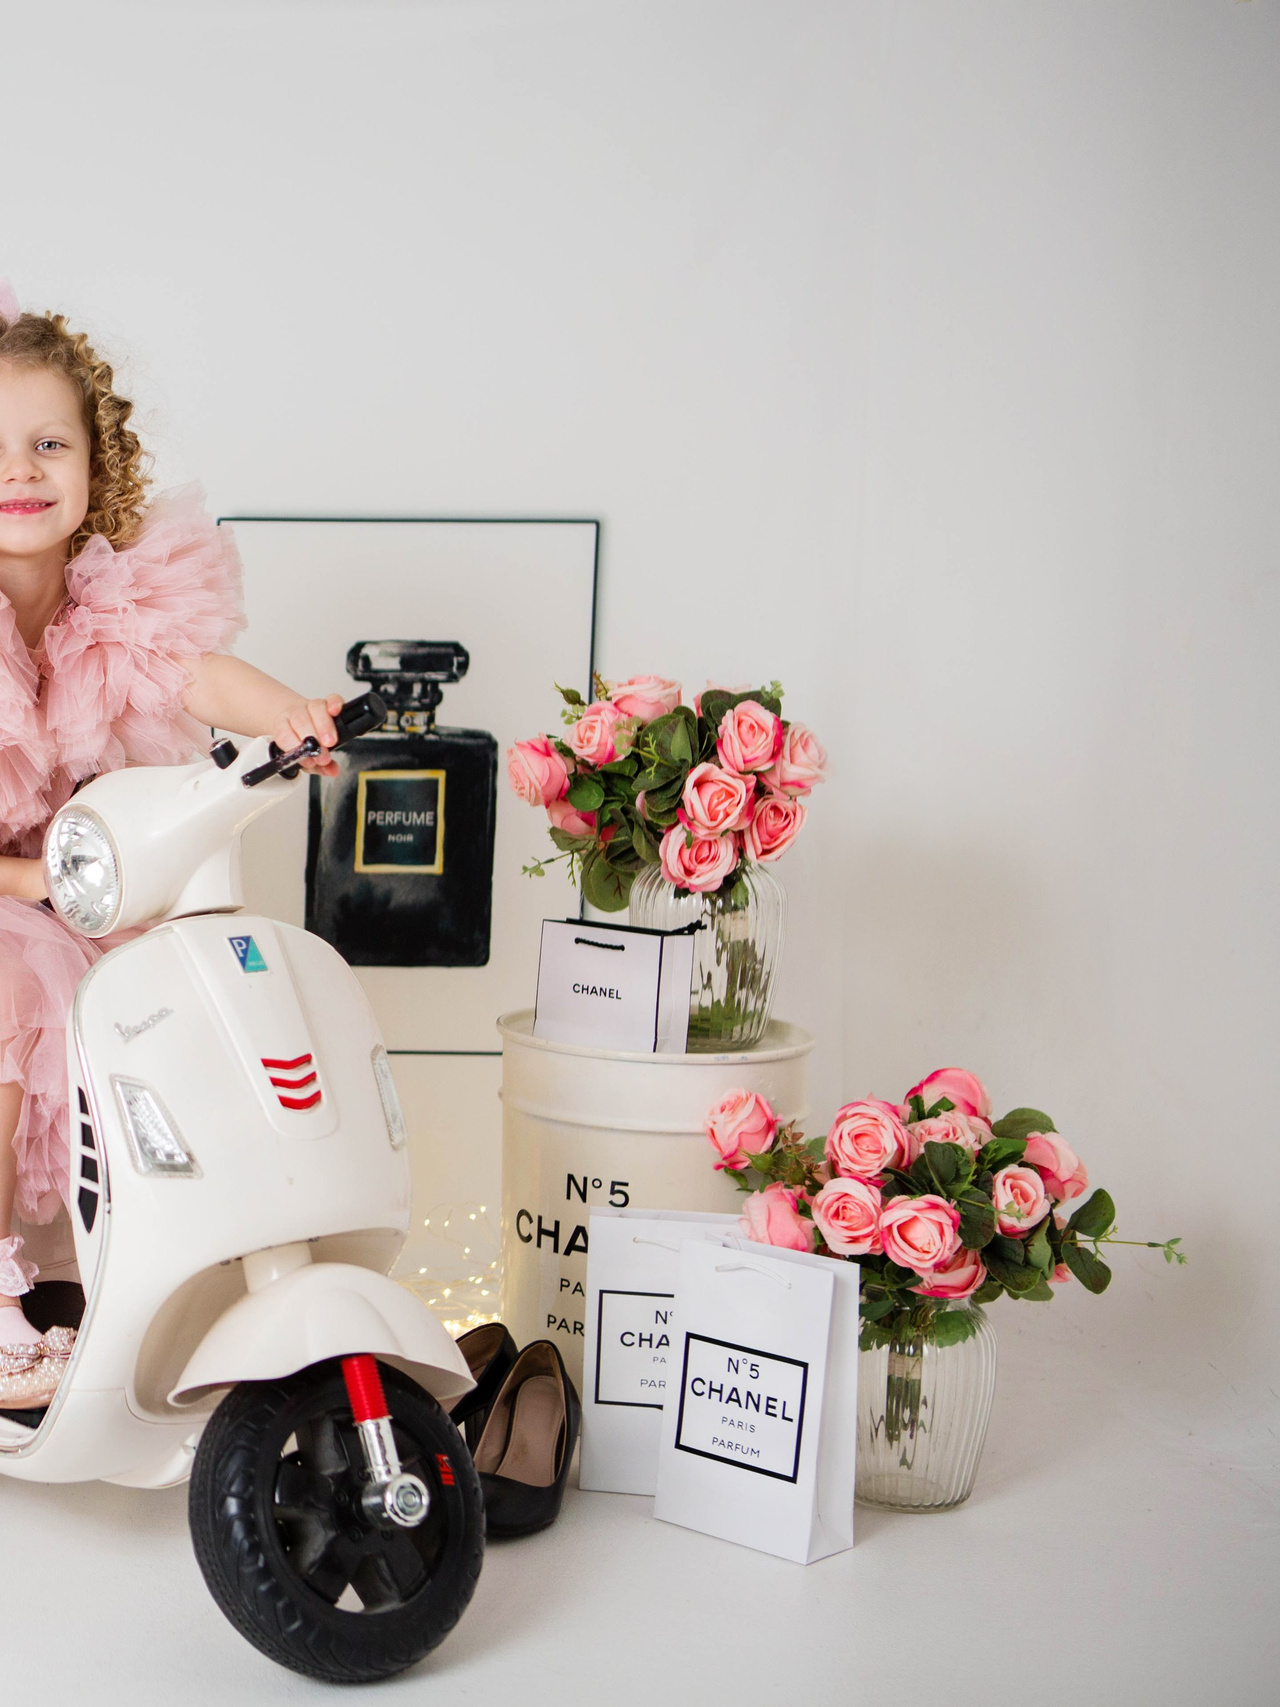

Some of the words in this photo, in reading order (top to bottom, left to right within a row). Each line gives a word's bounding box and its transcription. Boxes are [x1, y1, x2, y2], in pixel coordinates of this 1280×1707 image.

[367, 810, 435, 826] PERFUME
[231, 939, 247, 958] P
[572, 983, 622, 1000] CHANEL
[516, 1208, 589, 1257] CHA
[547, 1313, 585, 1337] PAR
[620, 1331, 670, 1349] CHA
[640, 1379, 667, 1389] PAR
[691, 1377, 794, 1423] CHANEL
[721, 1416, 756, 1433] PARIS
[711, 1436, 760, 1458] PARFUM
